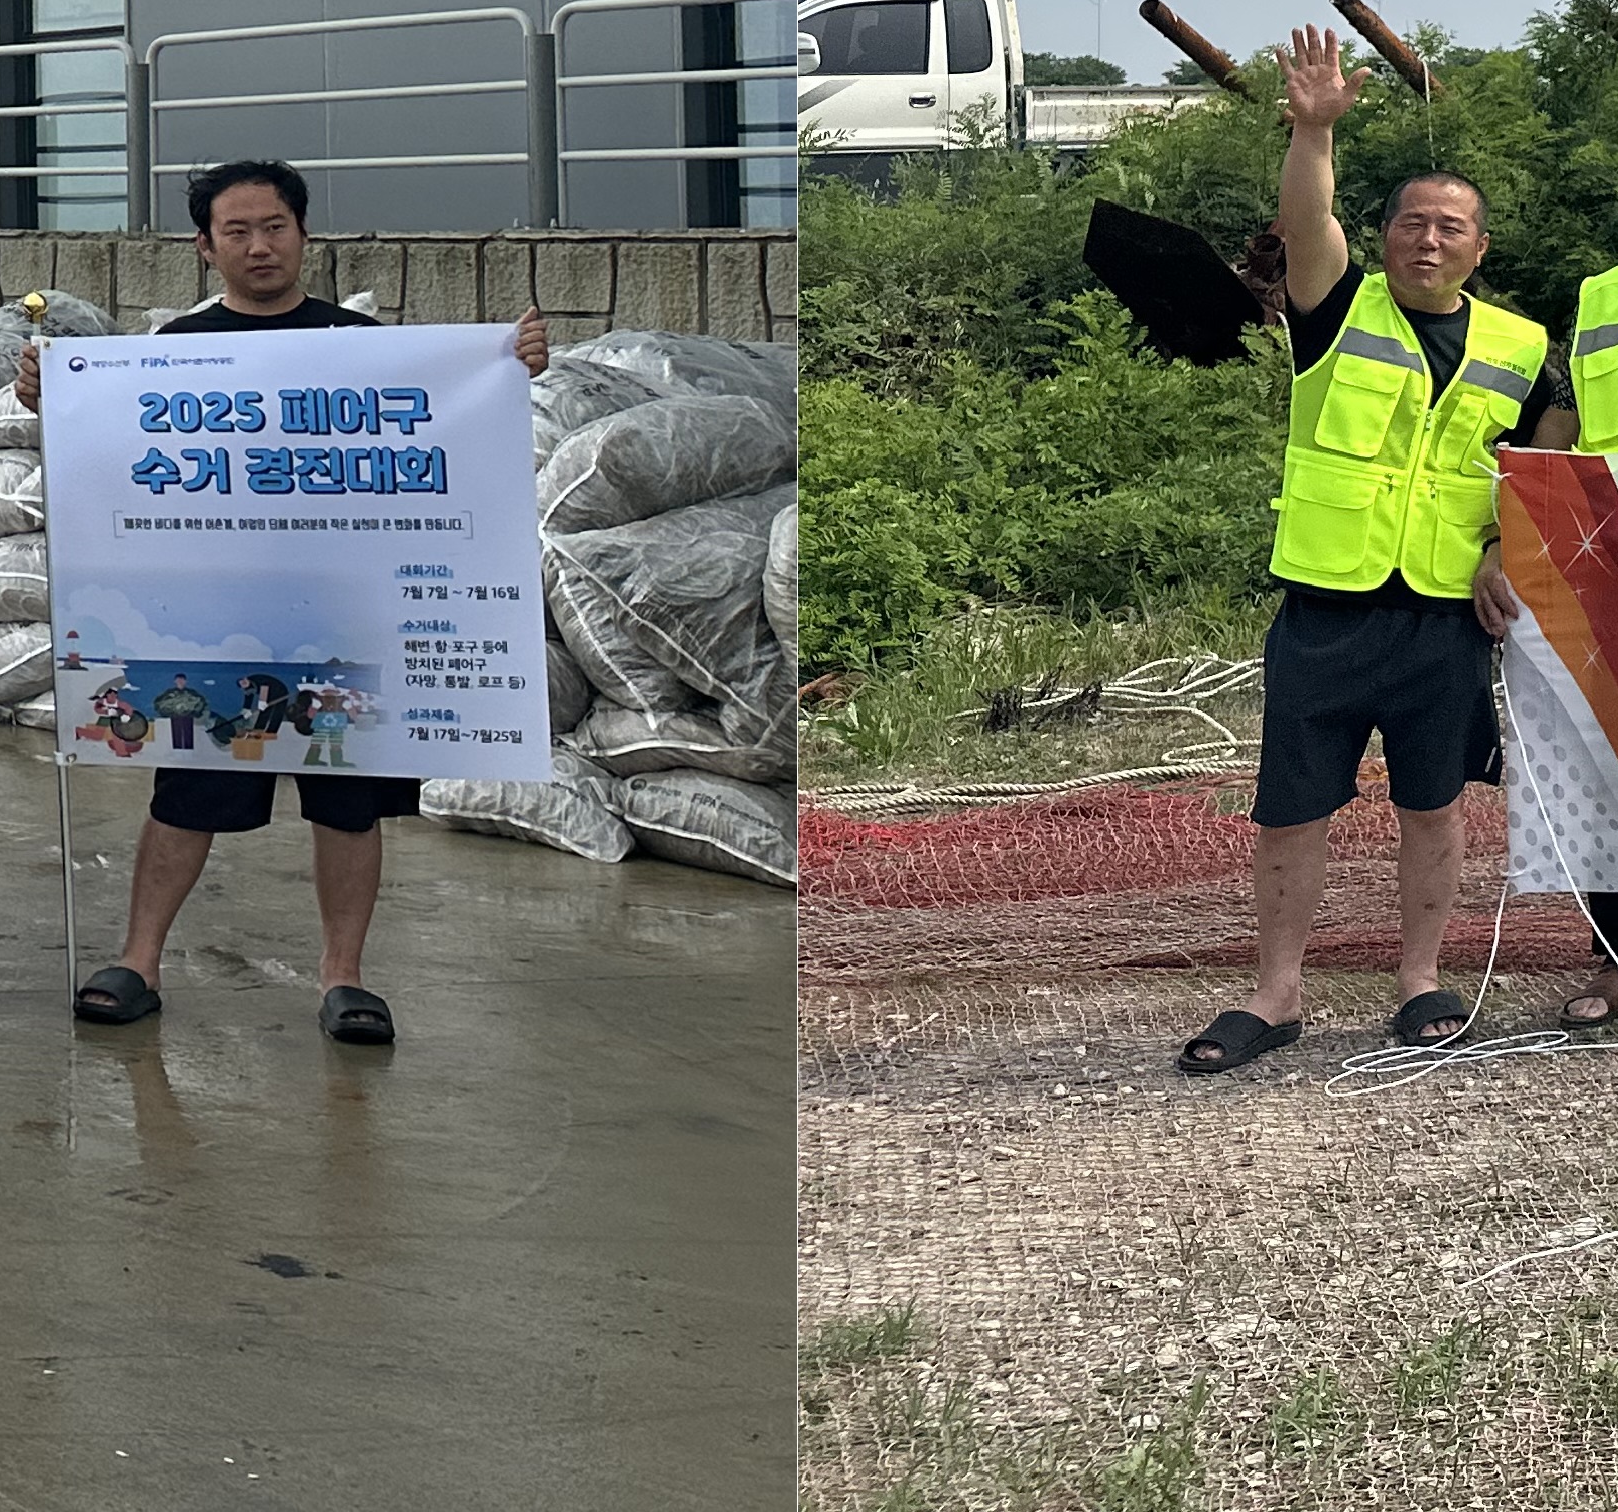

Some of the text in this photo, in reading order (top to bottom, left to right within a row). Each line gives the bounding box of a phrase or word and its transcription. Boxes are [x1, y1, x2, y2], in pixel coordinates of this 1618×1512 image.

[139, 387, 432, 436] 2025 폐어구
[131, 446, 449, 496] 수거 경진대회
[400, 564, 448, 577] 대회기간
[402, 586, 423, 600] 7월
[426, 586, 448, 600] 7일
[466, 586, 488, 600] 7월
[491, 586, 520, 600] 16일
[403, 620, 451, 632] 수거대상
[482, 640, 508, 654] 등에
[404, 657, 487, 671] 방치된 폐어구
[477, 676, 504, 688] 로프
[508, 676, 526, 689] 등)
[408, 727, 429, 741] 7월
